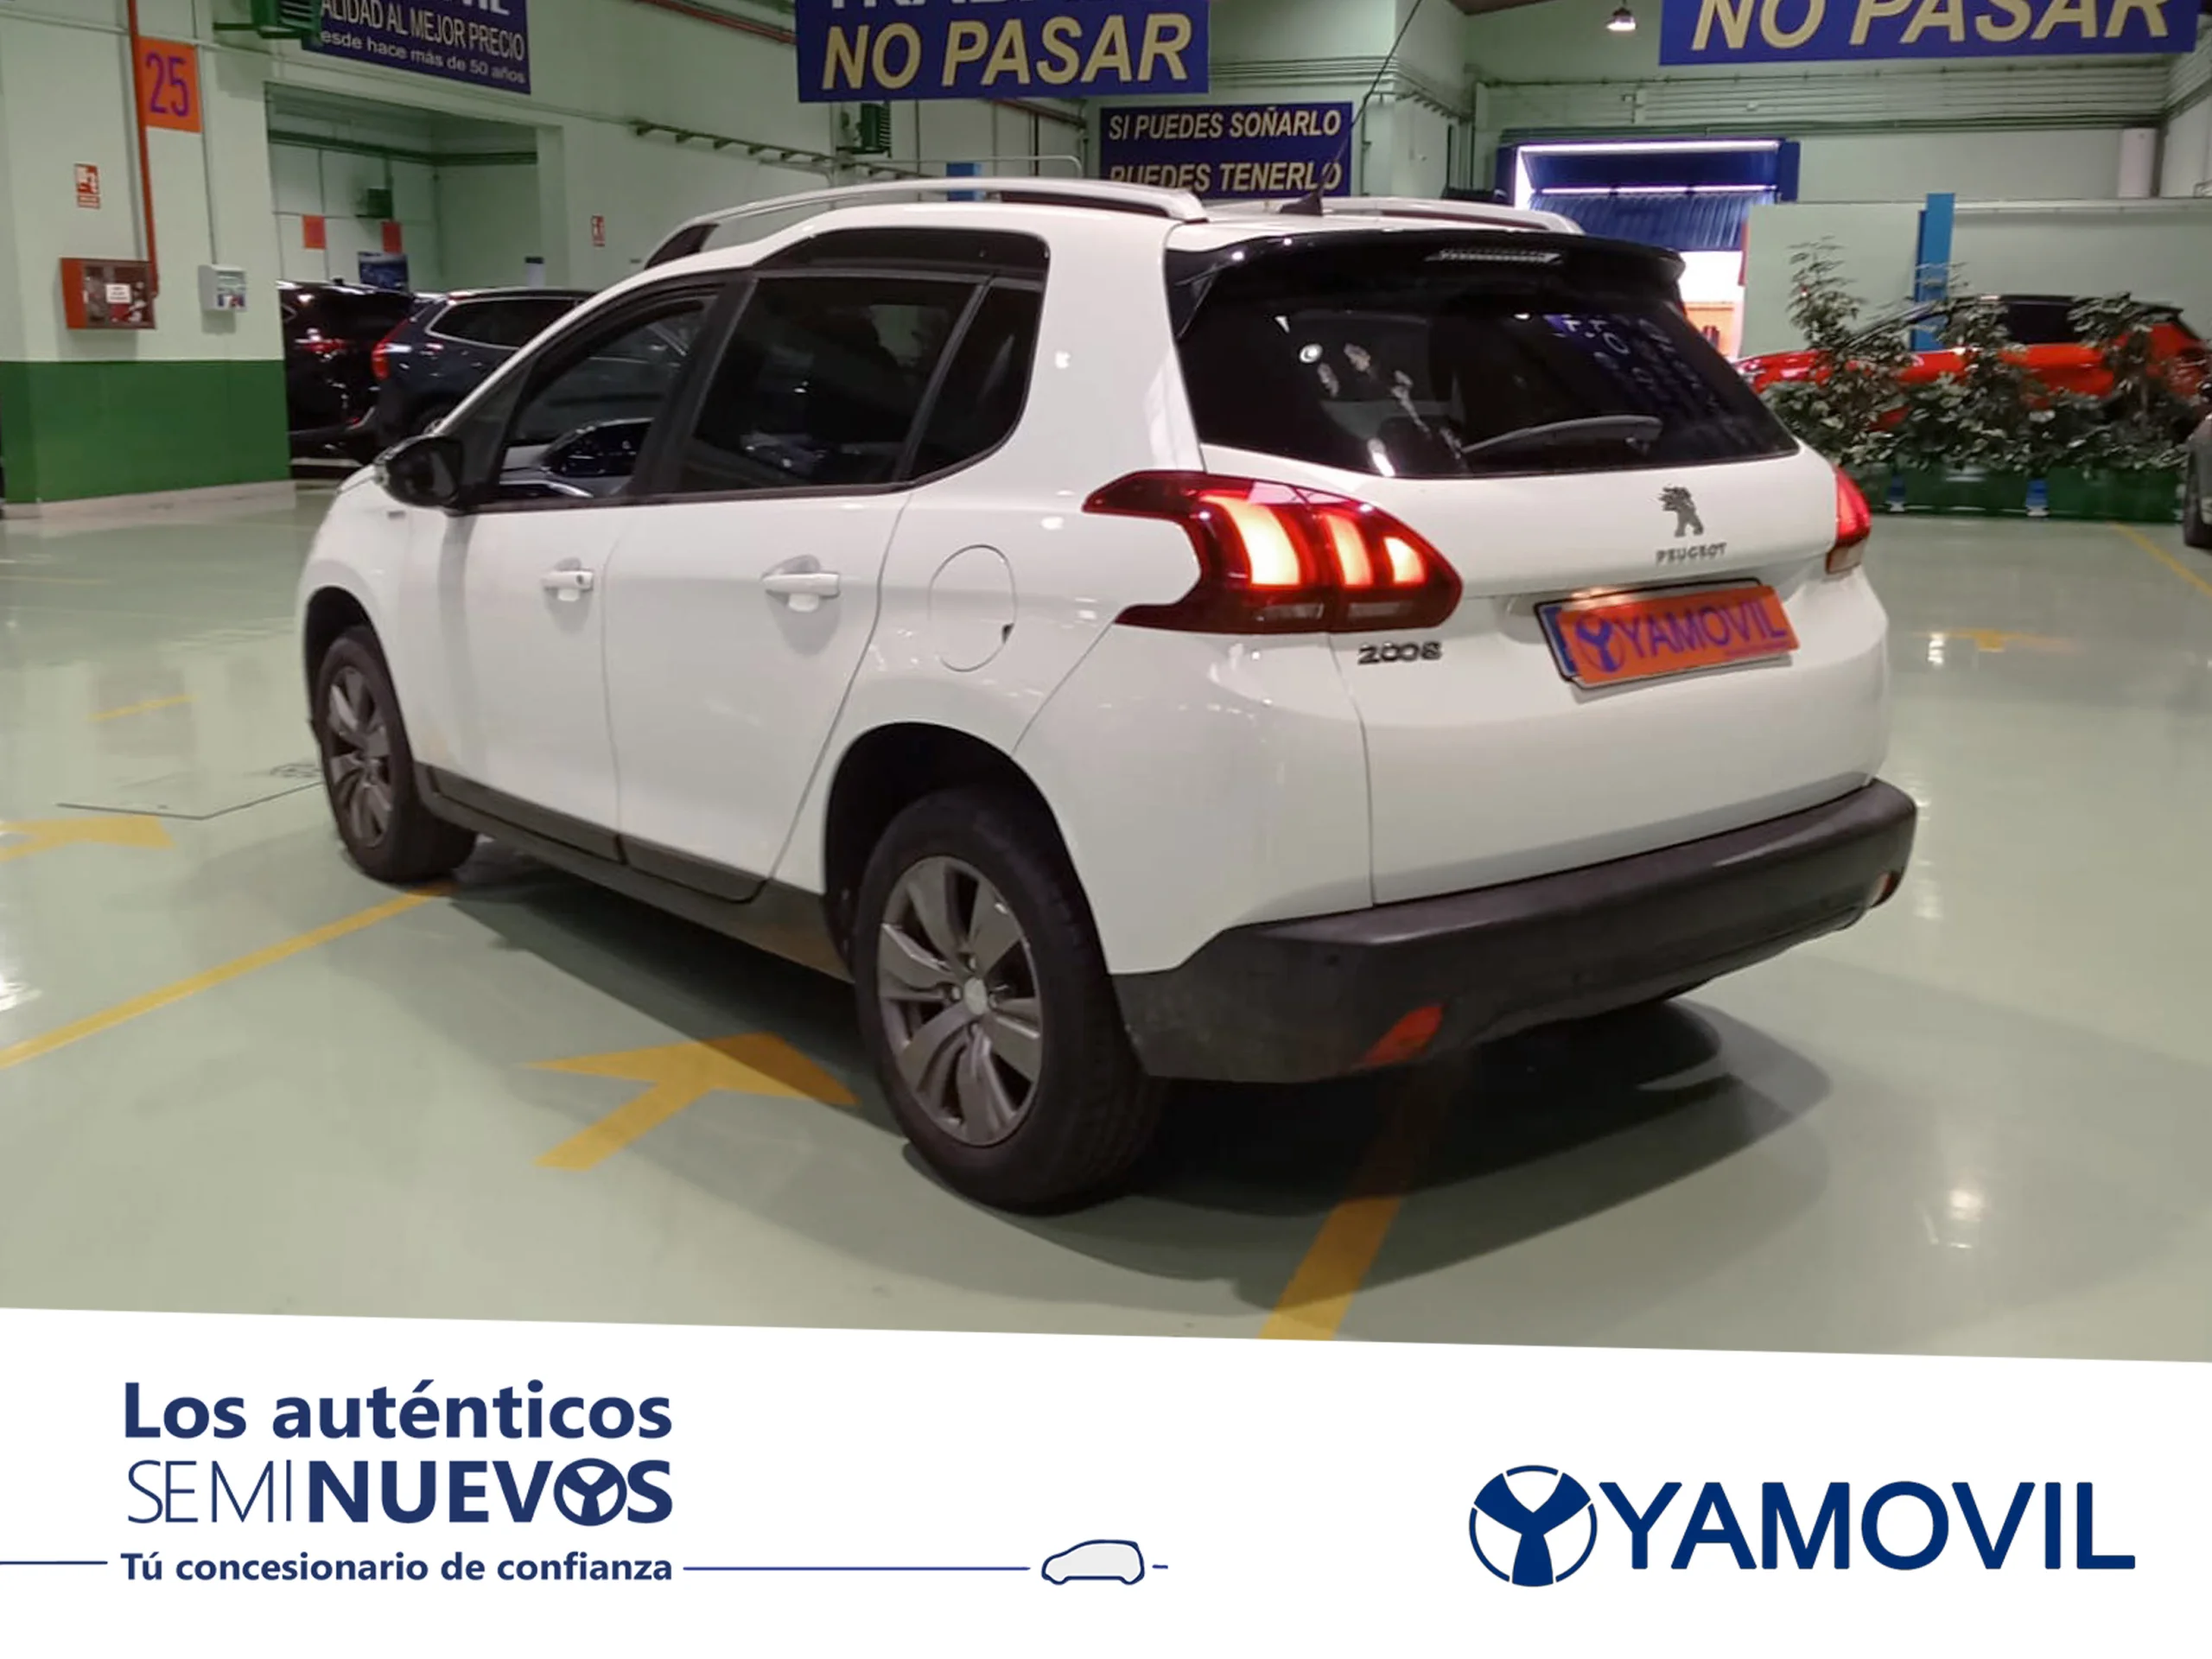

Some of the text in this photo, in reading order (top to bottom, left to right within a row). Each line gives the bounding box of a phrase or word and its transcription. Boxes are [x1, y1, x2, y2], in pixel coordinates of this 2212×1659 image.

[321, 0, 383, 29] ALIDAD
[386, 6, 409, 35] AL
[410, 7, 465, 48] MEJOR
[468, 22, 525, 61] PRECIO
[1691, 0, 1823, 50] NO
[321, 29, 363, 50] esde
[366, 35, 408, 60] hace
[410, 48, 444, 68] más
[447, 56, 467, 72] de
[470, 60, 490, 76] 50
[822, 12, 1192, 91] NO PASAR
[145, 52, 190, 118] 25
[1109, 107, 1341, 140] SI PUEDES SOÑARLO
[1109, 162, 1342, 192] PUEDES TENERLO
[1656, 542, 1727, 565] PEUGEOT
[1357, 641, 1442, 664] 2008
[1616, 599, 1785, 659] YAMOVIL
